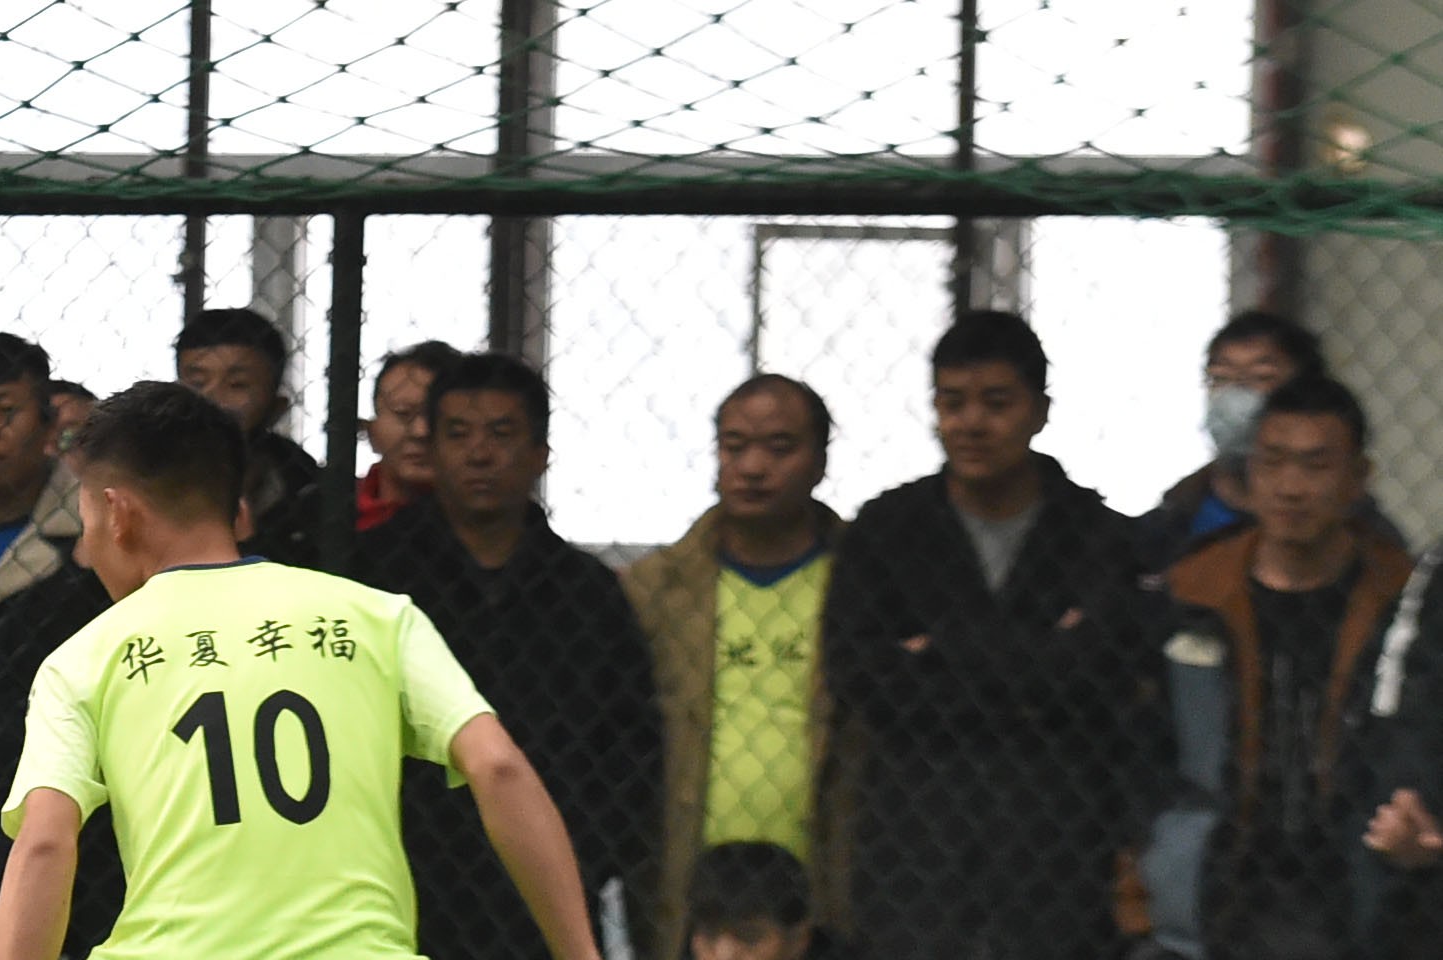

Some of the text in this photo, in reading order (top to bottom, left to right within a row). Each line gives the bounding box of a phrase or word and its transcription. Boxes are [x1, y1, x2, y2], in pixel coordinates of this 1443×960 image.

[121, 616, 357, 684] 华夏幸福
[171, 689, 331, 826] 10
